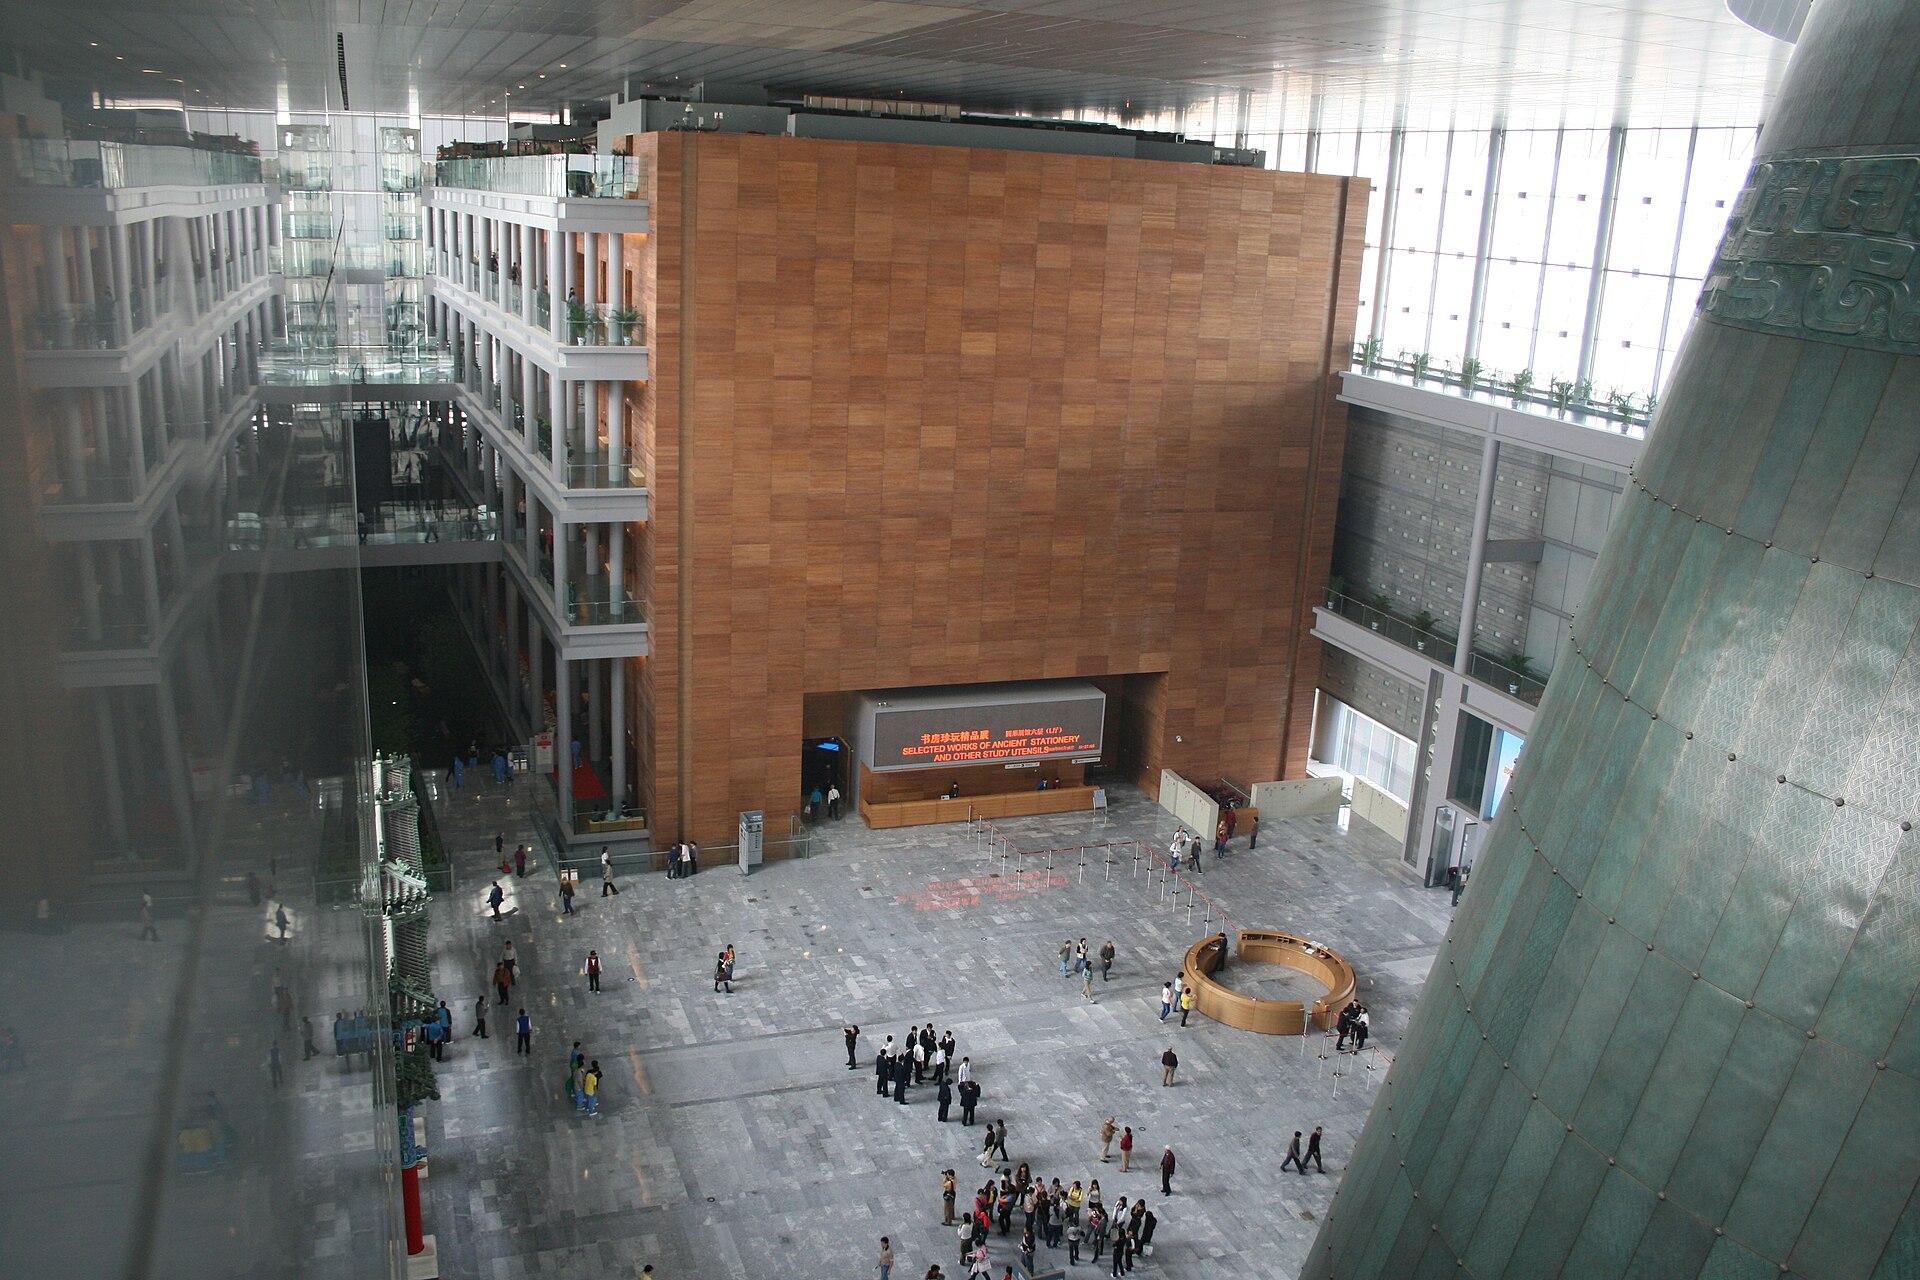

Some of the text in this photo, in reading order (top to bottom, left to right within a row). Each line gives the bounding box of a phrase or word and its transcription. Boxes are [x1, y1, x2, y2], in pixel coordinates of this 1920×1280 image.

[902, 745, 946, 755] SELECTED
[947, 743, 977, 752] WORKS
[991, 739, 1027, 748] ANCIENT
[1030, 735, 1080, 745] STATIONERY
[920, 730, 989, 744] 书房珍玩精品展
[933, 754, 952, 762] AND
[953, 752, 981, 760] OTHER
[982, 749, 1009, 758] STUDY
[1011, 746, 1049, 756] UTENSILS
